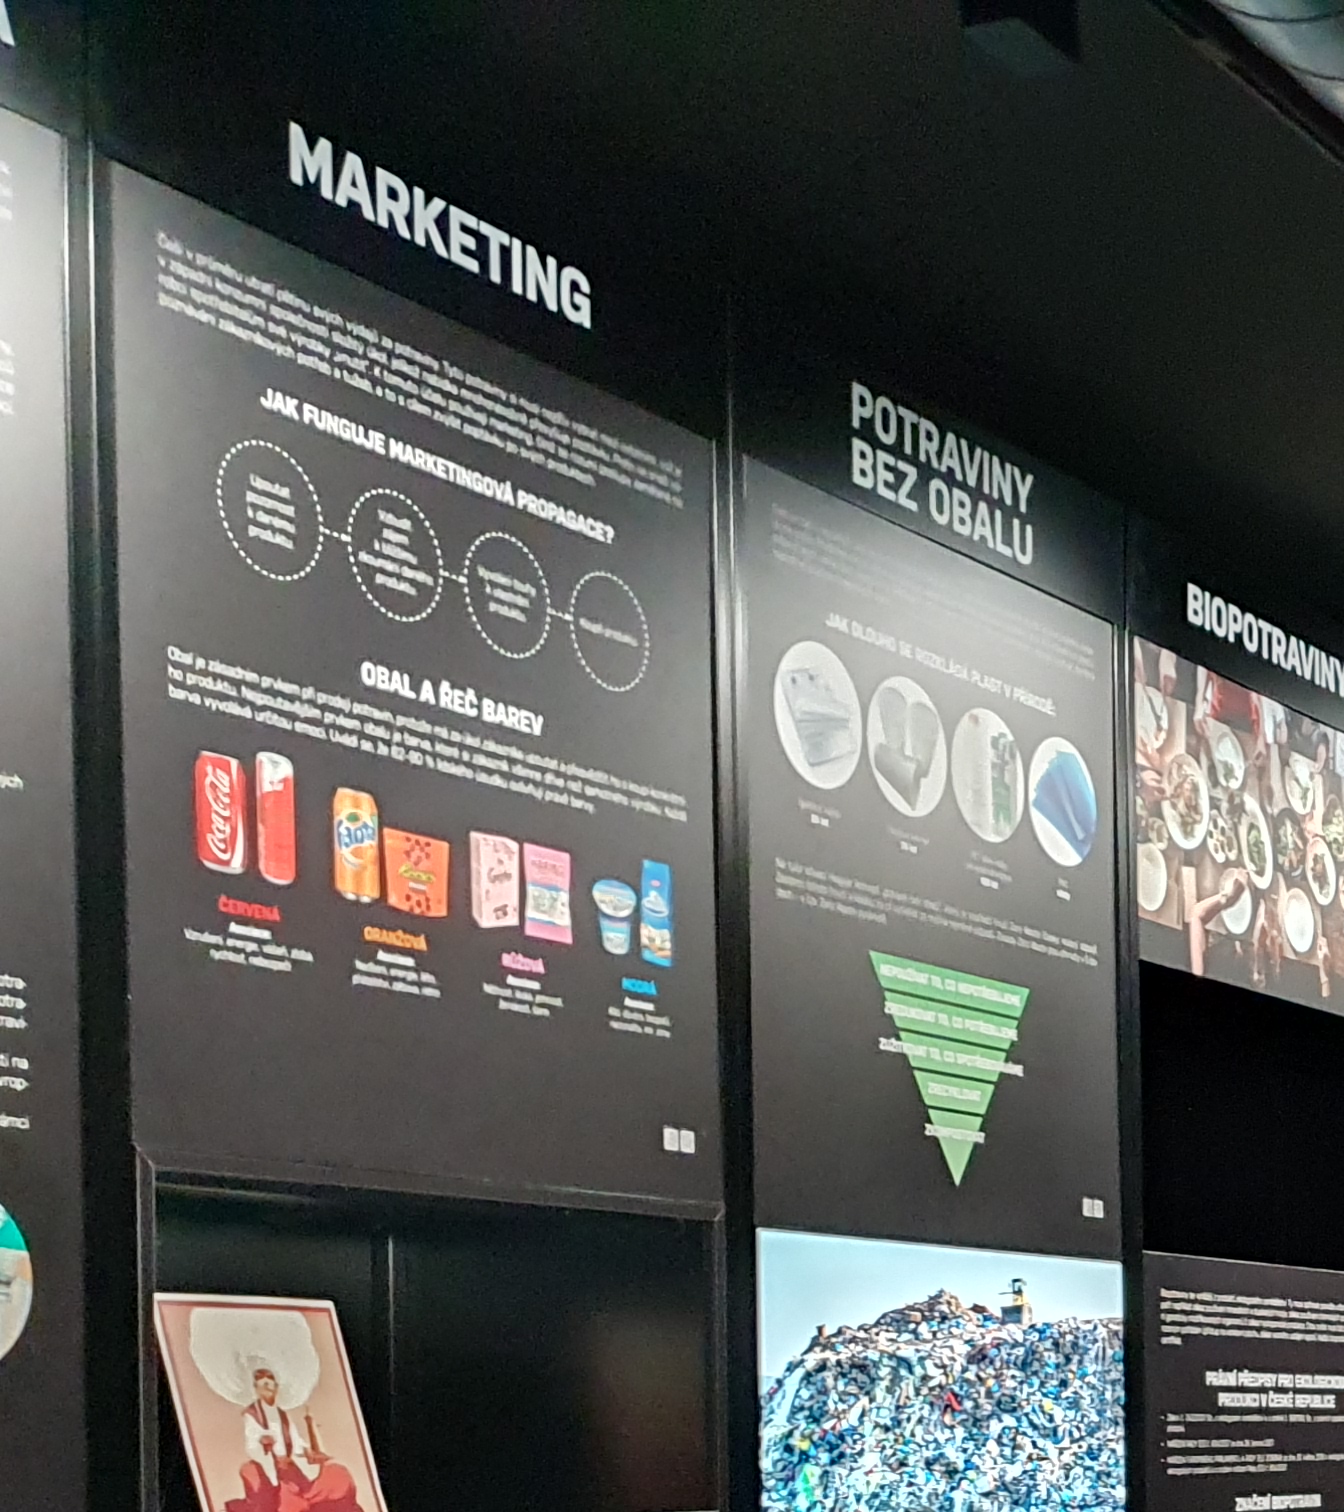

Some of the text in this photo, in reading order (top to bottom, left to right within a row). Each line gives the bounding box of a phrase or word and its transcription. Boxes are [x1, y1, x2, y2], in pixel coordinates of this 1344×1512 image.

[288, 120, 592, 329] MARKETING
[260, 387, 615, 544] JAK FUNGUJE MARKETINGOVÁ PROPAGACE?
[851, 379, 1034, 514] POTRAVINY
[851, 436, 1034, 567] BEZ OBALU
[825, 612, 849, 634] JAK
[360, 661, 544, 736] OBAL A ŘEČ BAREV
